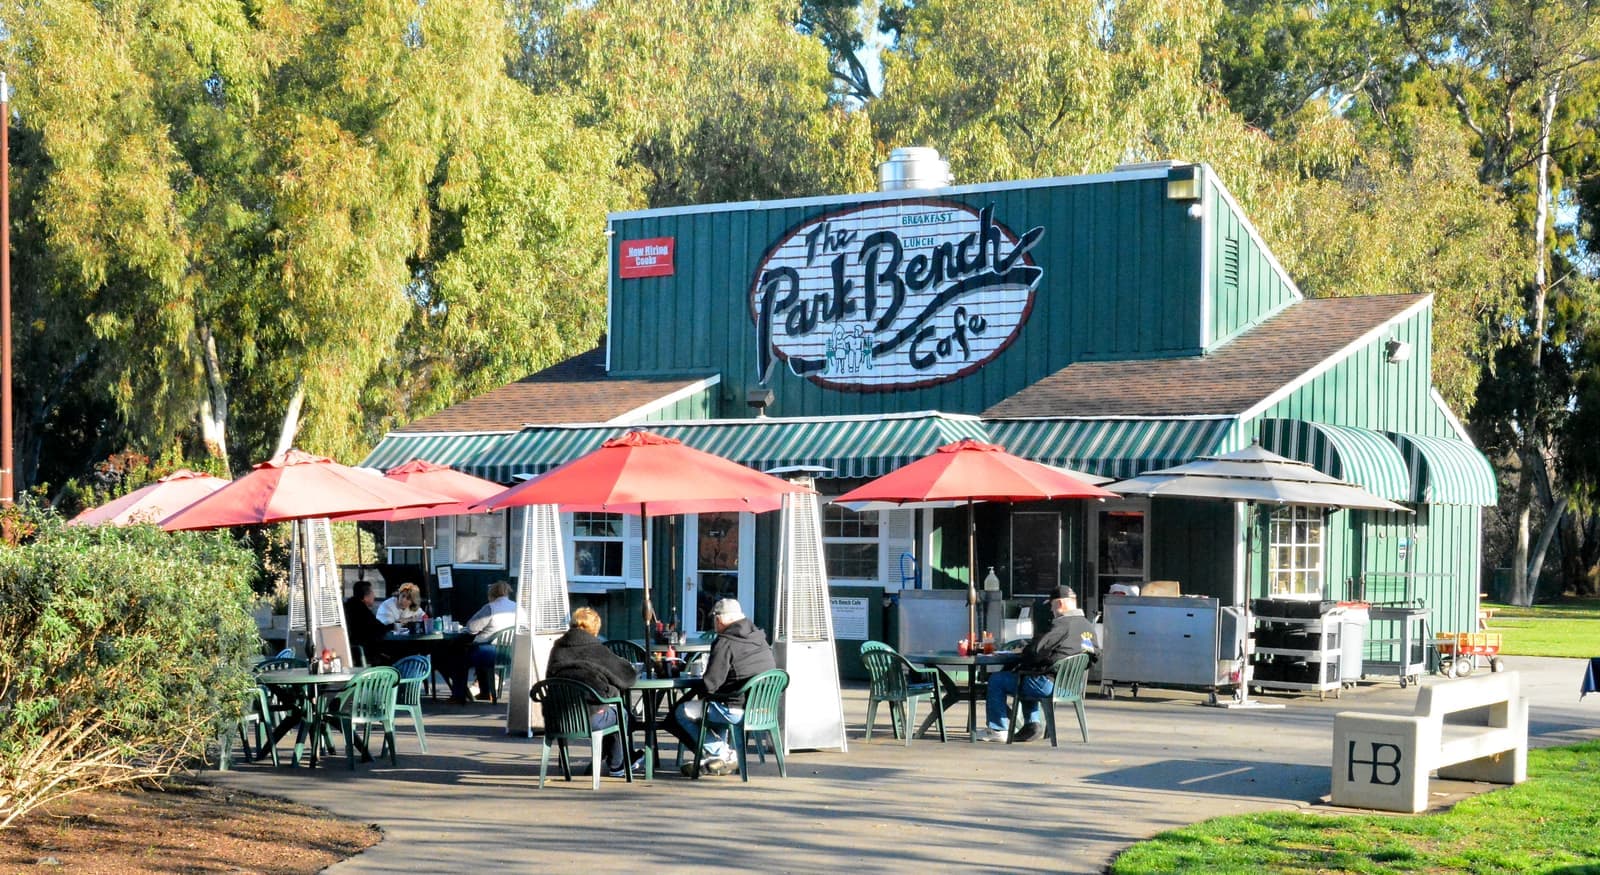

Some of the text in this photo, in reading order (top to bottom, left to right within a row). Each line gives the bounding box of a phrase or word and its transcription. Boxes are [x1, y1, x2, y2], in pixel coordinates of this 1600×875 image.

[902, 212, 953, 225] BREAKFAST
[628, 244, 669, 257] Now Hiring
[805, 221, 858, 267] The
[903, 237, 935, 248] LUNCH
[756, 201, 1046, 385] Park Bench
[909, 306, 987, 370] Cafe
[1347, 740, 1402, 786] HB
